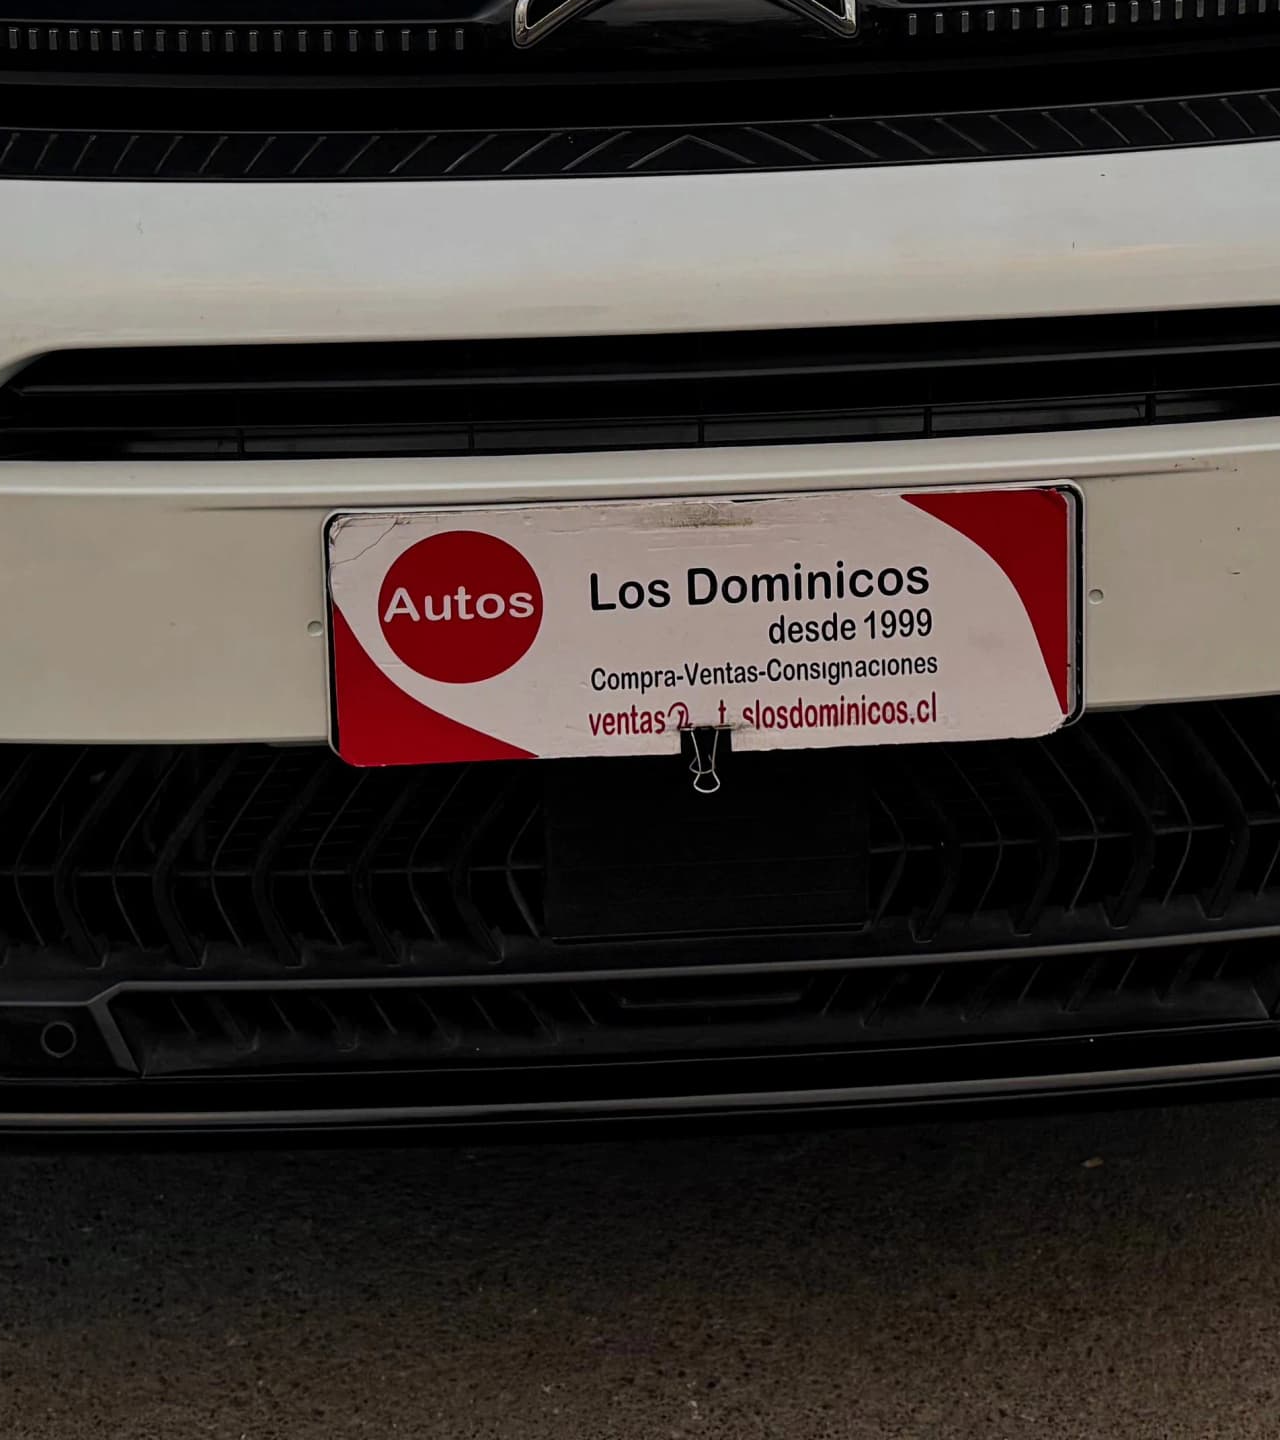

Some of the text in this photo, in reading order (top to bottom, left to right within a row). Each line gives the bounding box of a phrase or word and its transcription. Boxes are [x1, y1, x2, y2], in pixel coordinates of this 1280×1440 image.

[383, 586, 535, 622] Autos
[590, 560, 930, 611] Los Dominicos
[768, 607, 932, 644] desde 1999
